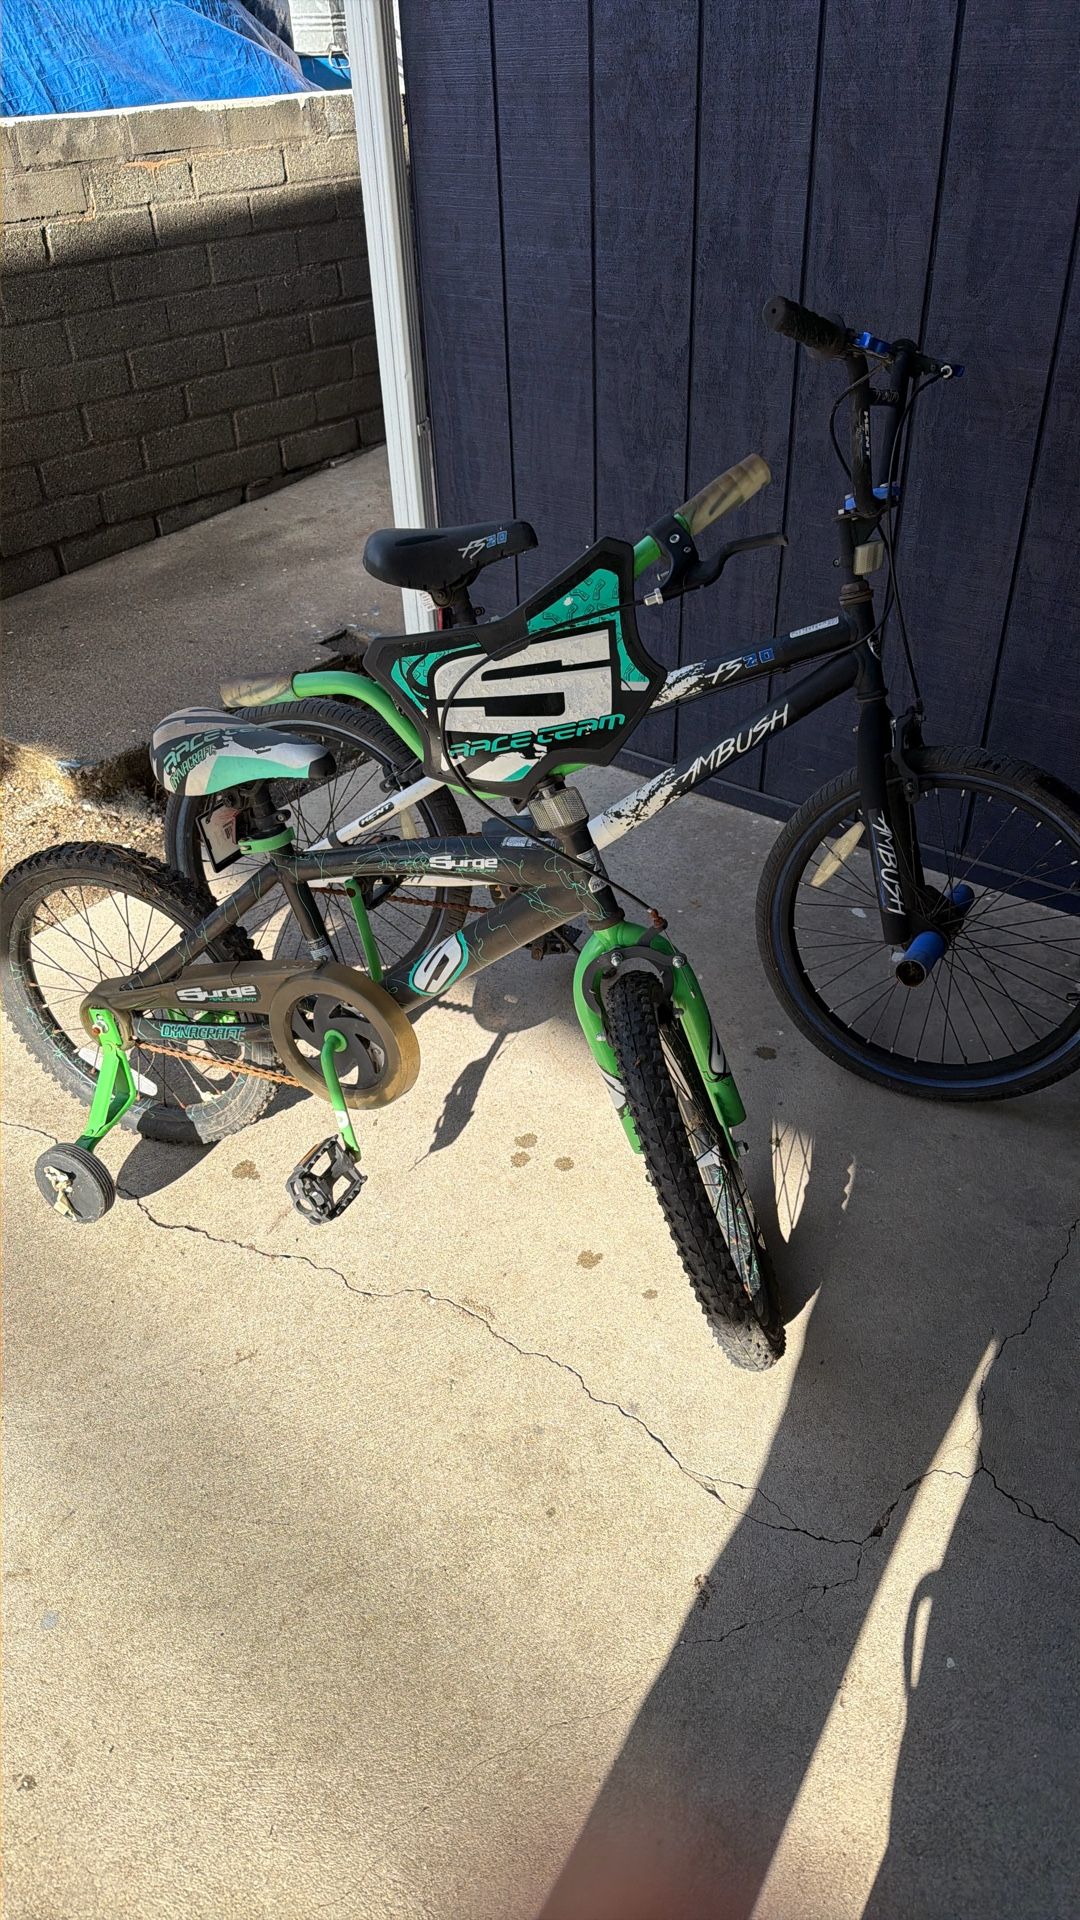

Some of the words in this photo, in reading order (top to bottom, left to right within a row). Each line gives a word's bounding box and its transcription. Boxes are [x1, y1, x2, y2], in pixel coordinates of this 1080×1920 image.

[673, 703, 789, 785] AMBUSH
[360, 802, 391, 826] KENT
[429, 855, 498, 870] Surge
[872, 809, 907, 916] AMBUSH
[176, 985, 257, 1002] Surge
[160, 1024, 246, 1041] DYNACRAFT
